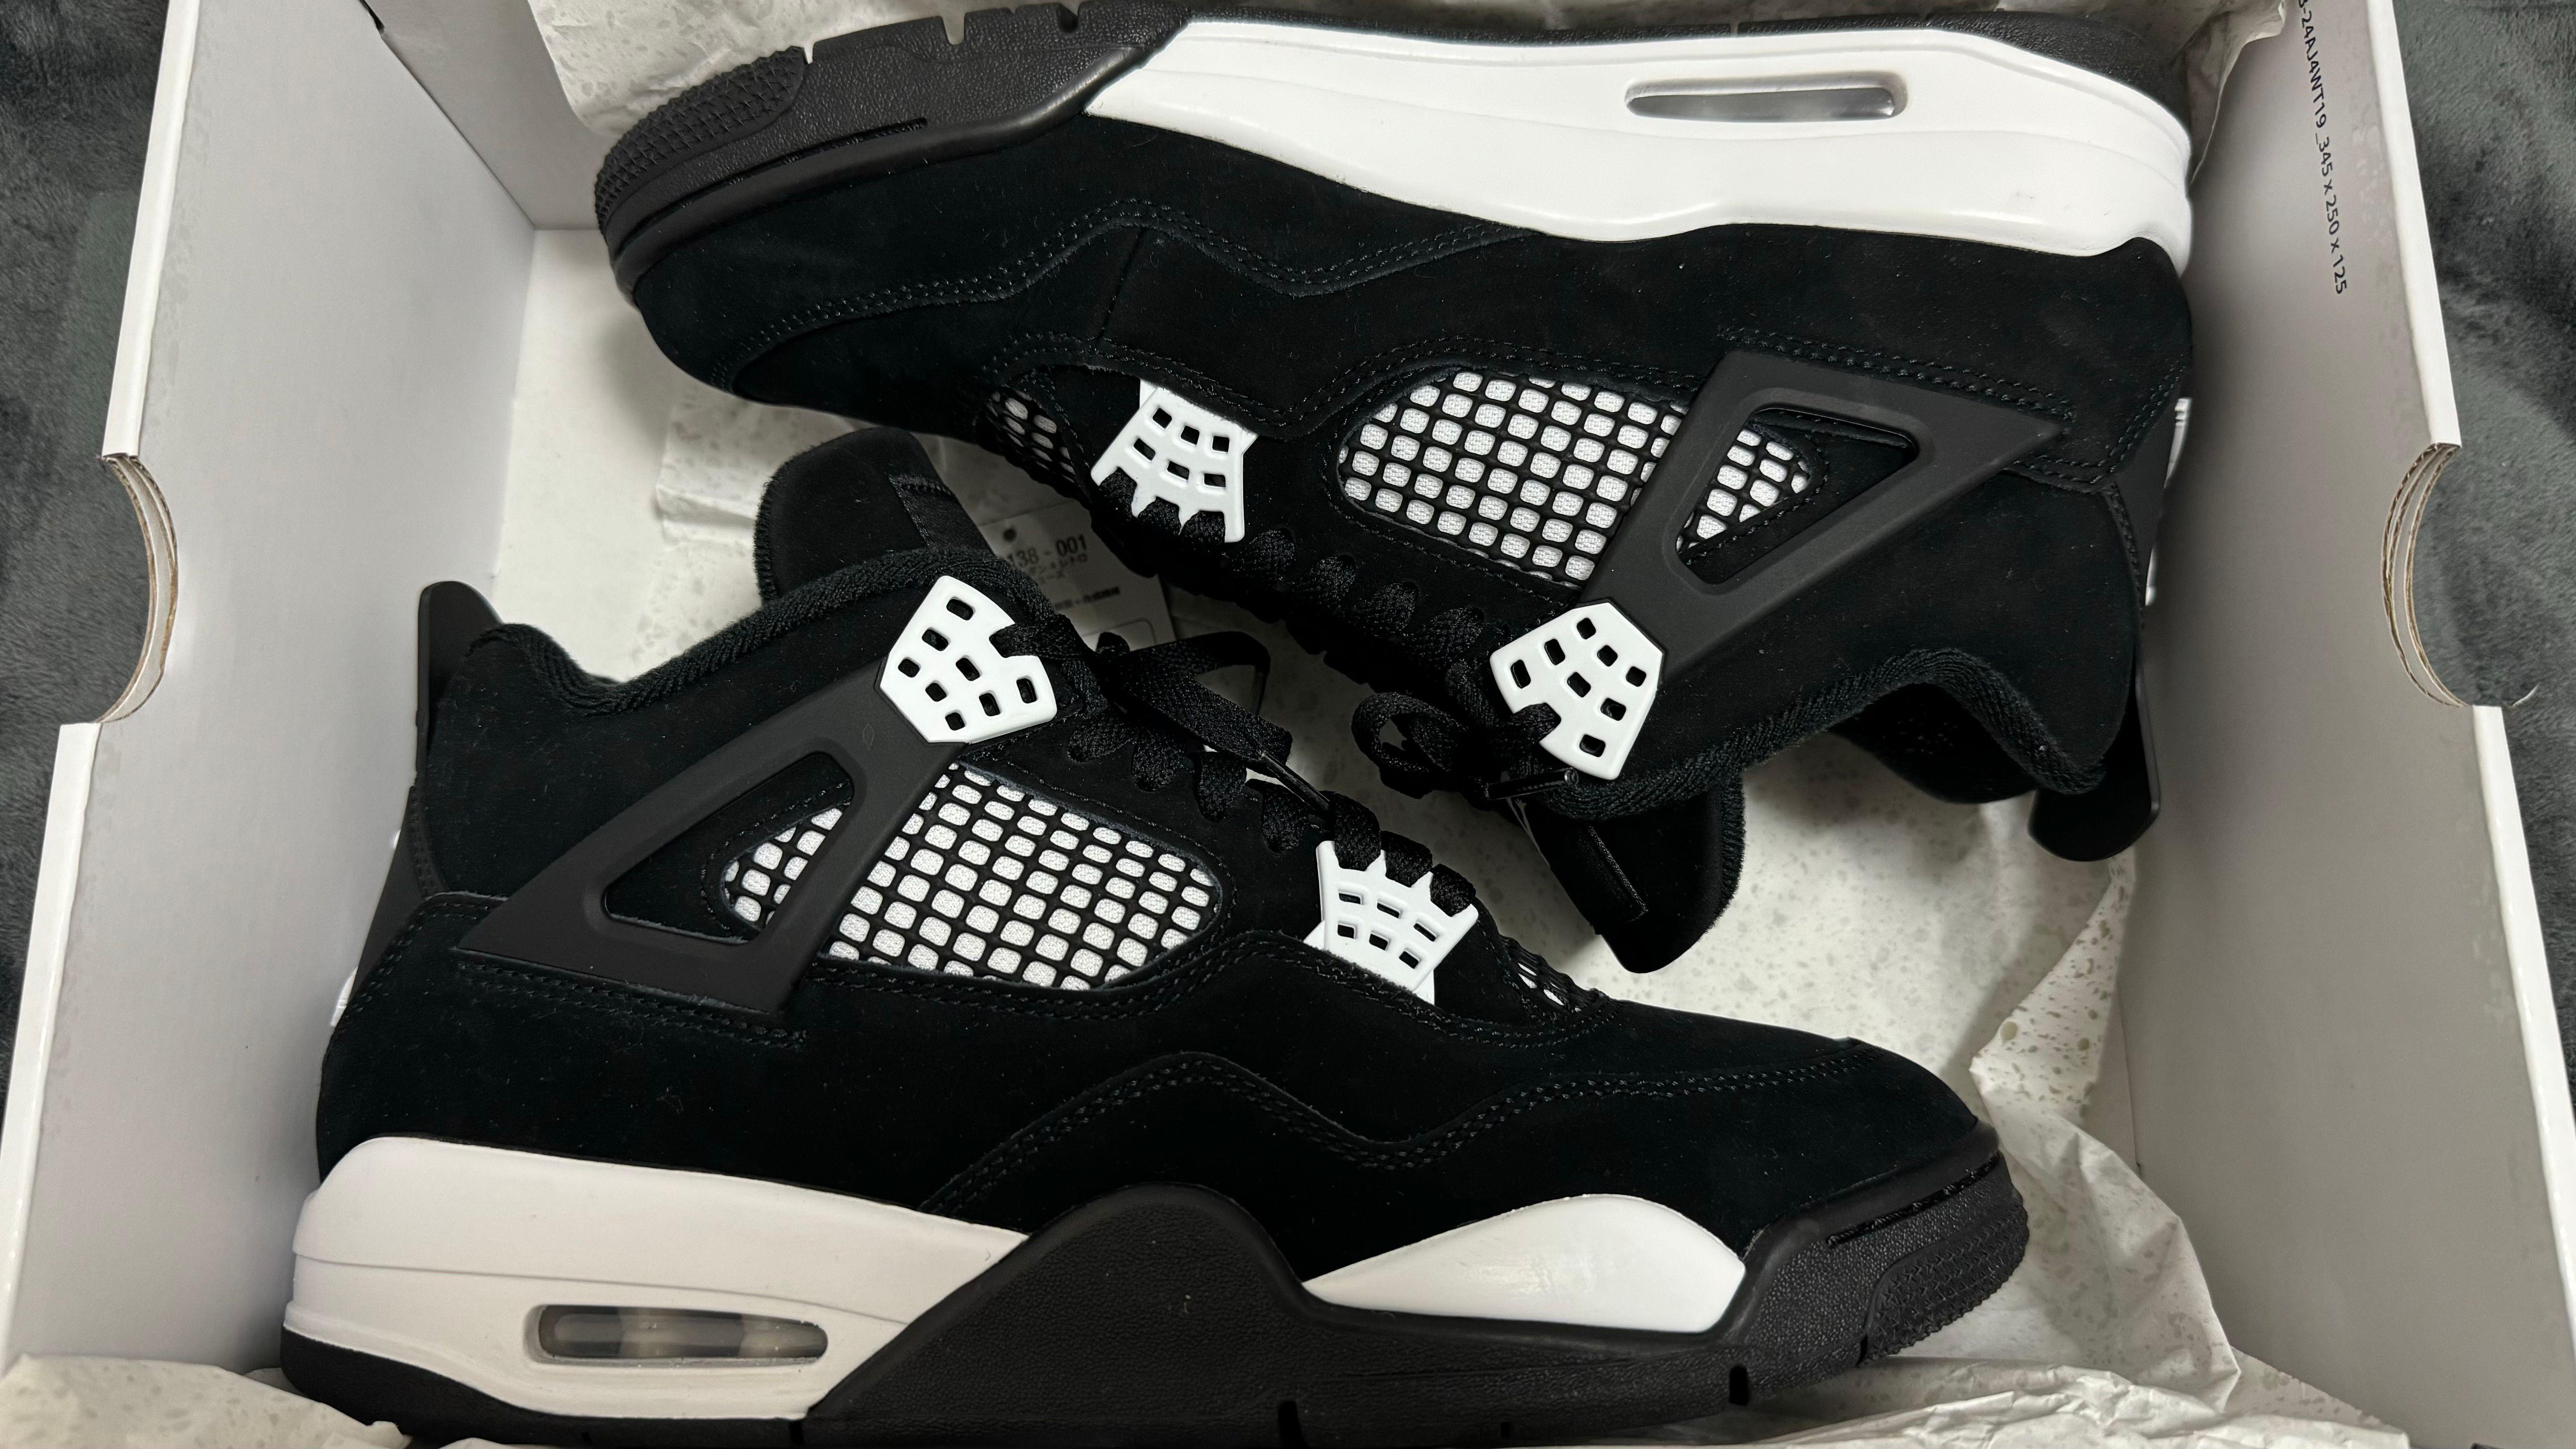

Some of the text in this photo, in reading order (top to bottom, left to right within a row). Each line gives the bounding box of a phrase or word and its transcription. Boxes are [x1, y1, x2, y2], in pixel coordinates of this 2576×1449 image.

[2324, 179, 2333, 195] x
[2326, 194, 2340, 235] 250
[2331, 237, 2340, 253] x
[2333, 255, 2347, 294] 125
[1056, 534, 1087, 557] 001
